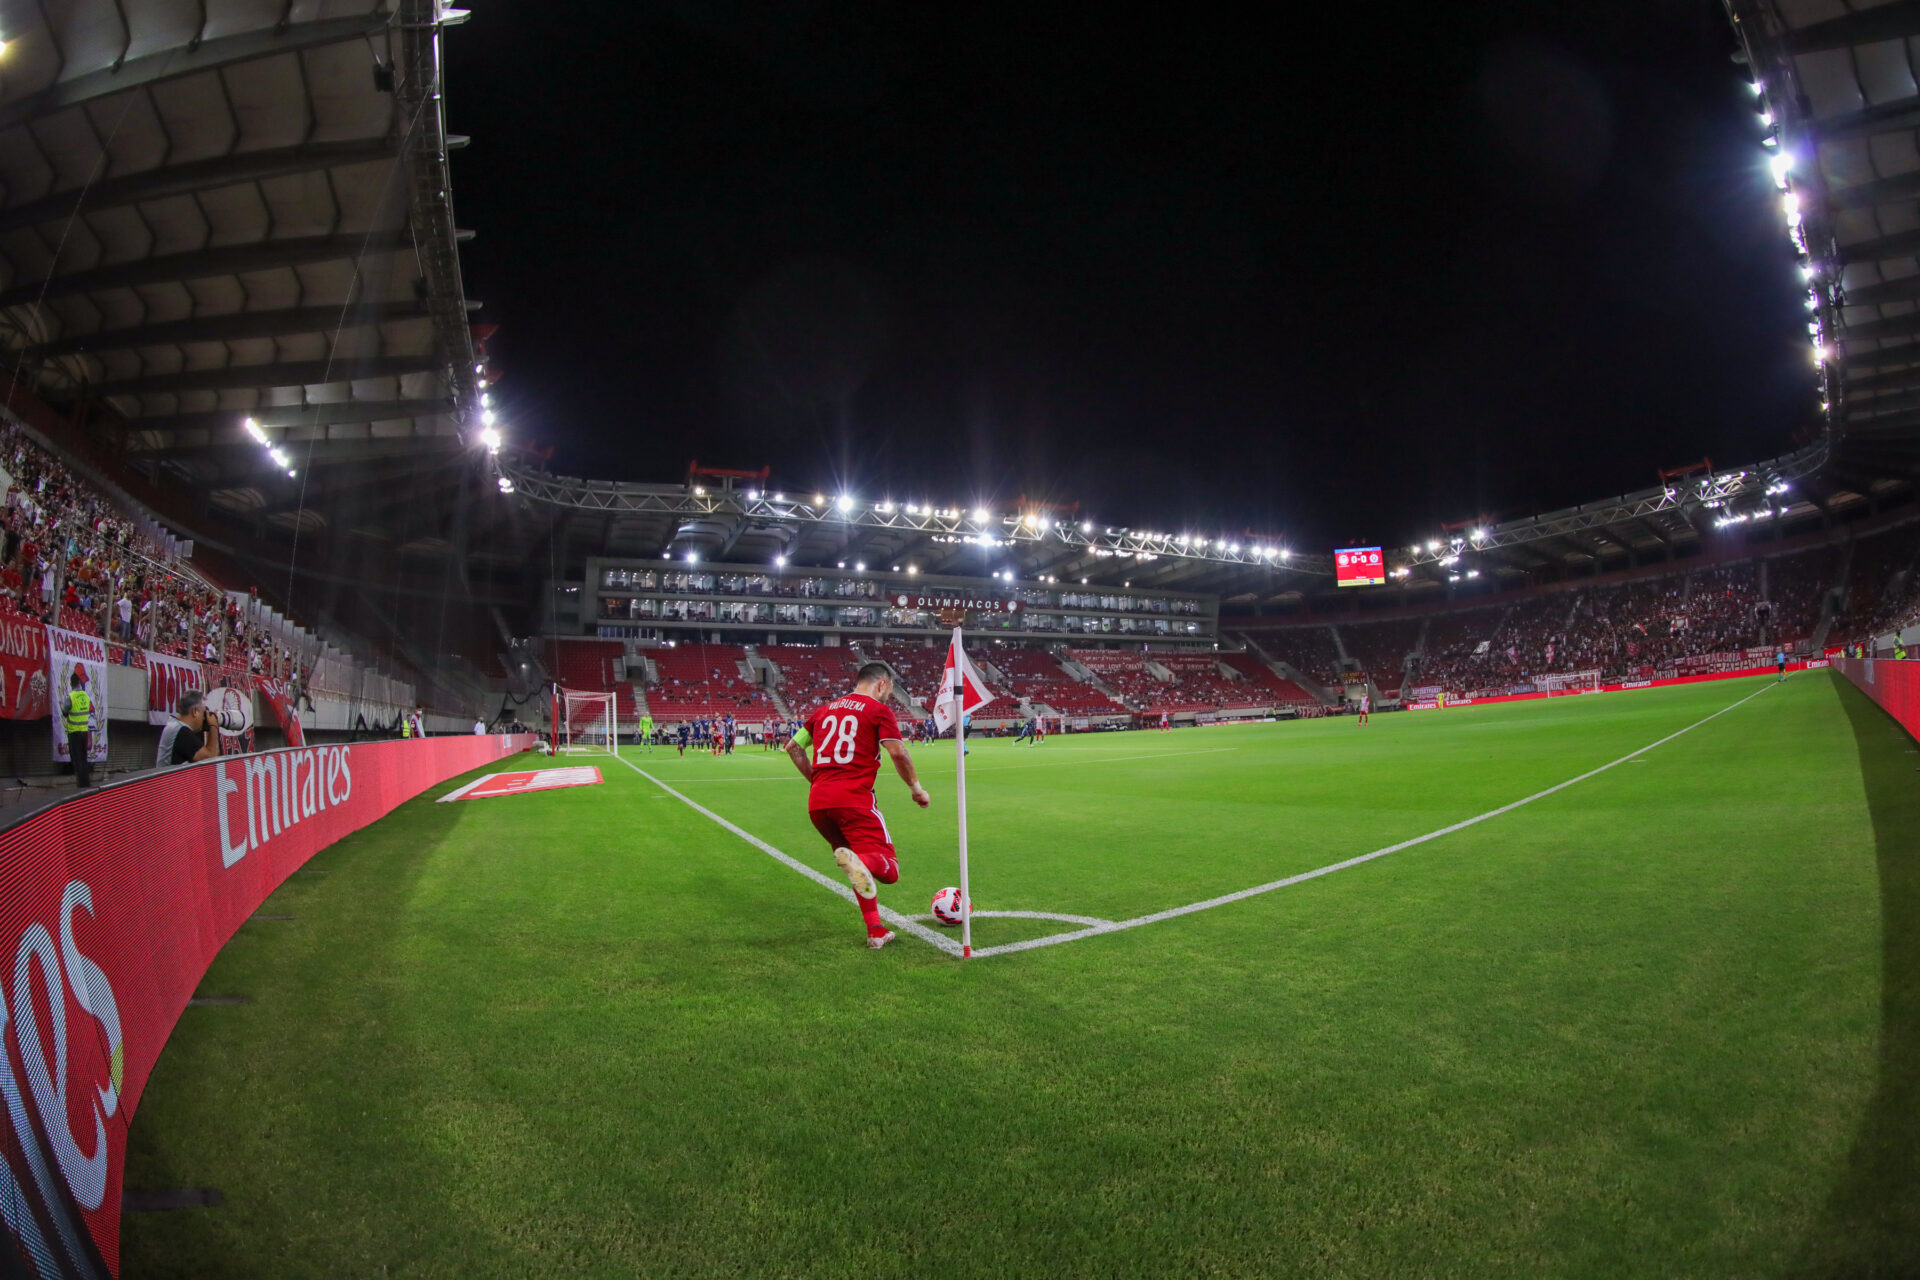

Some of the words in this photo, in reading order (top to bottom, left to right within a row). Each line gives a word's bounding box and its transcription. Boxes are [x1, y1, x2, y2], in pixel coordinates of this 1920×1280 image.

[917, 597, 1000, 609] OLYMPIACOS
[1621, 680, 1651, 689] Emirates
[1409, 703, 1437, 711] Emirates
[816, 714, 859, 765] 28
[216, 744, 352, 869] Emirates
